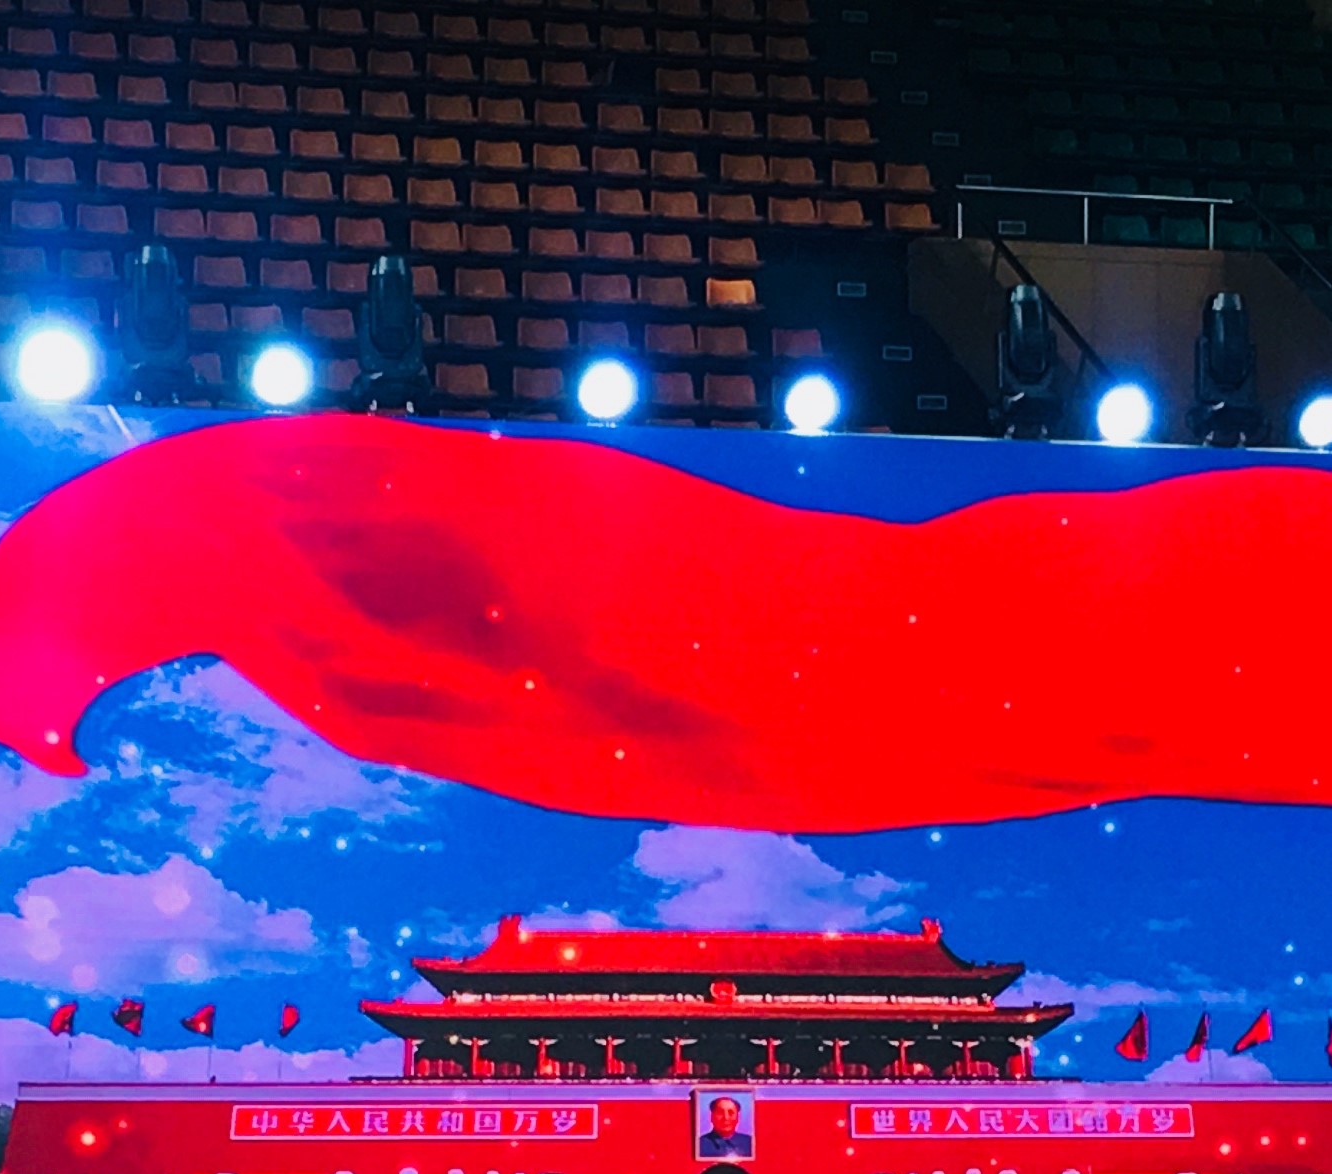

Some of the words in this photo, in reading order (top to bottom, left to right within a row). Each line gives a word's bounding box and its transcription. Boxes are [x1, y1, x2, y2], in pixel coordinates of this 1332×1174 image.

[251, 1108, 579, 1134] 中华人民共和国万岁
